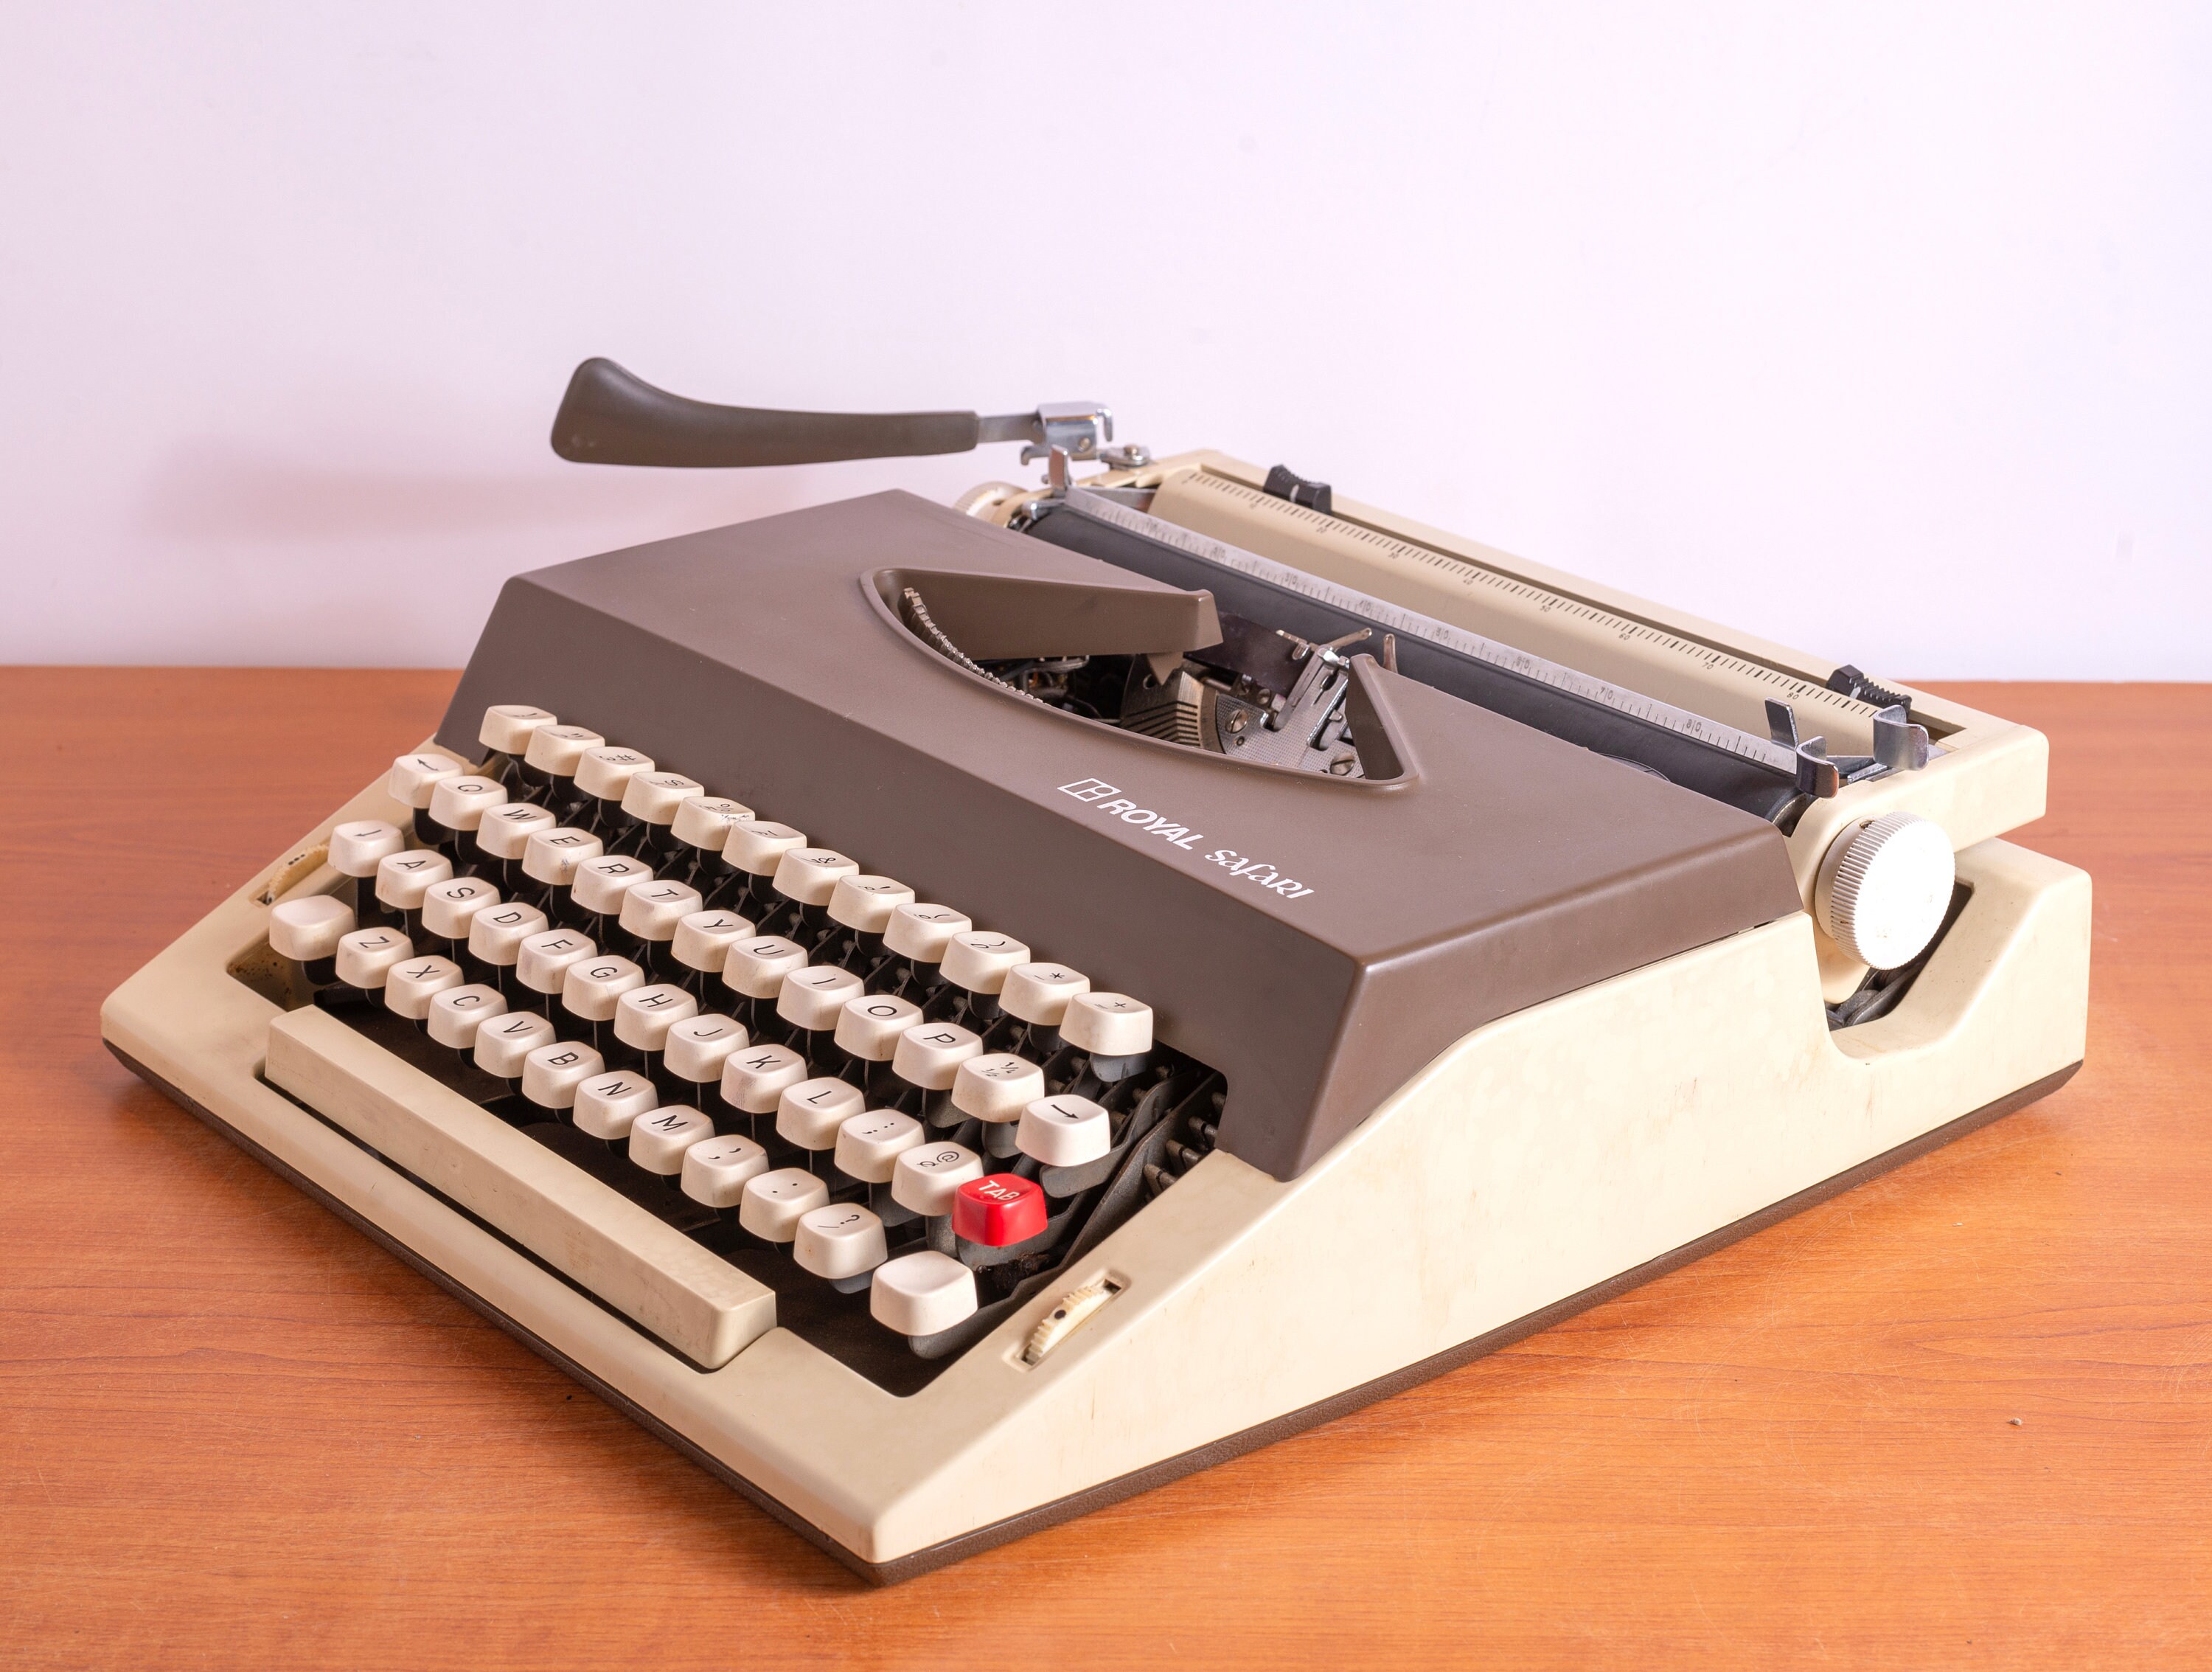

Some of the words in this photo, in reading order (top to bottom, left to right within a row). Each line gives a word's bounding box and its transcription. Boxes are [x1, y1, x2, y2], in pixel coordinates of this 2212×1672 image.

[1539, 604, 1552, 614] 50
[1618, 632, 1631, 642] 60
[1701, 661, 1714, 671] 70
[1787, 692, 1800, 701] 80
[1096, 798, 1204, 850] ROYAL
[396, 860, 427, 870] A
[446, 887, 476, 899] S
[492, 912, 522, 924] D
[540, 939, 574, 949] F
[590, 966, 618, 979] G
[638, 993, 673, 1007] H
[693, 1028, 723, 1037] J
[745, 1055, 782, 1069] K
[806, 1090, 832, 1105] L
[457, 784, 484, 792] Q
[503, 808, 538, 821] W
[550, 836, 581, 846] E
[597, 862, 630, 875] R
[650, 888, 679, 899] T
[703, 918, 734, 929] Y
[753, 944, 785, 956] U
[867, 1005, 897, 1017] O
[922, 1033, 956, 1044] P
[358, 936, 390, 948] Z
[406, 964, 441, 979] X
[453, 995, 481, 1007] C
[502, 1020, 534, 1033] V
[546, 1052, 579, 1066] B
[597, 1081, 632, 1097] N
[651, 1114, 689, 1131] M
[978, 1179, 1020, 1201] TAB
